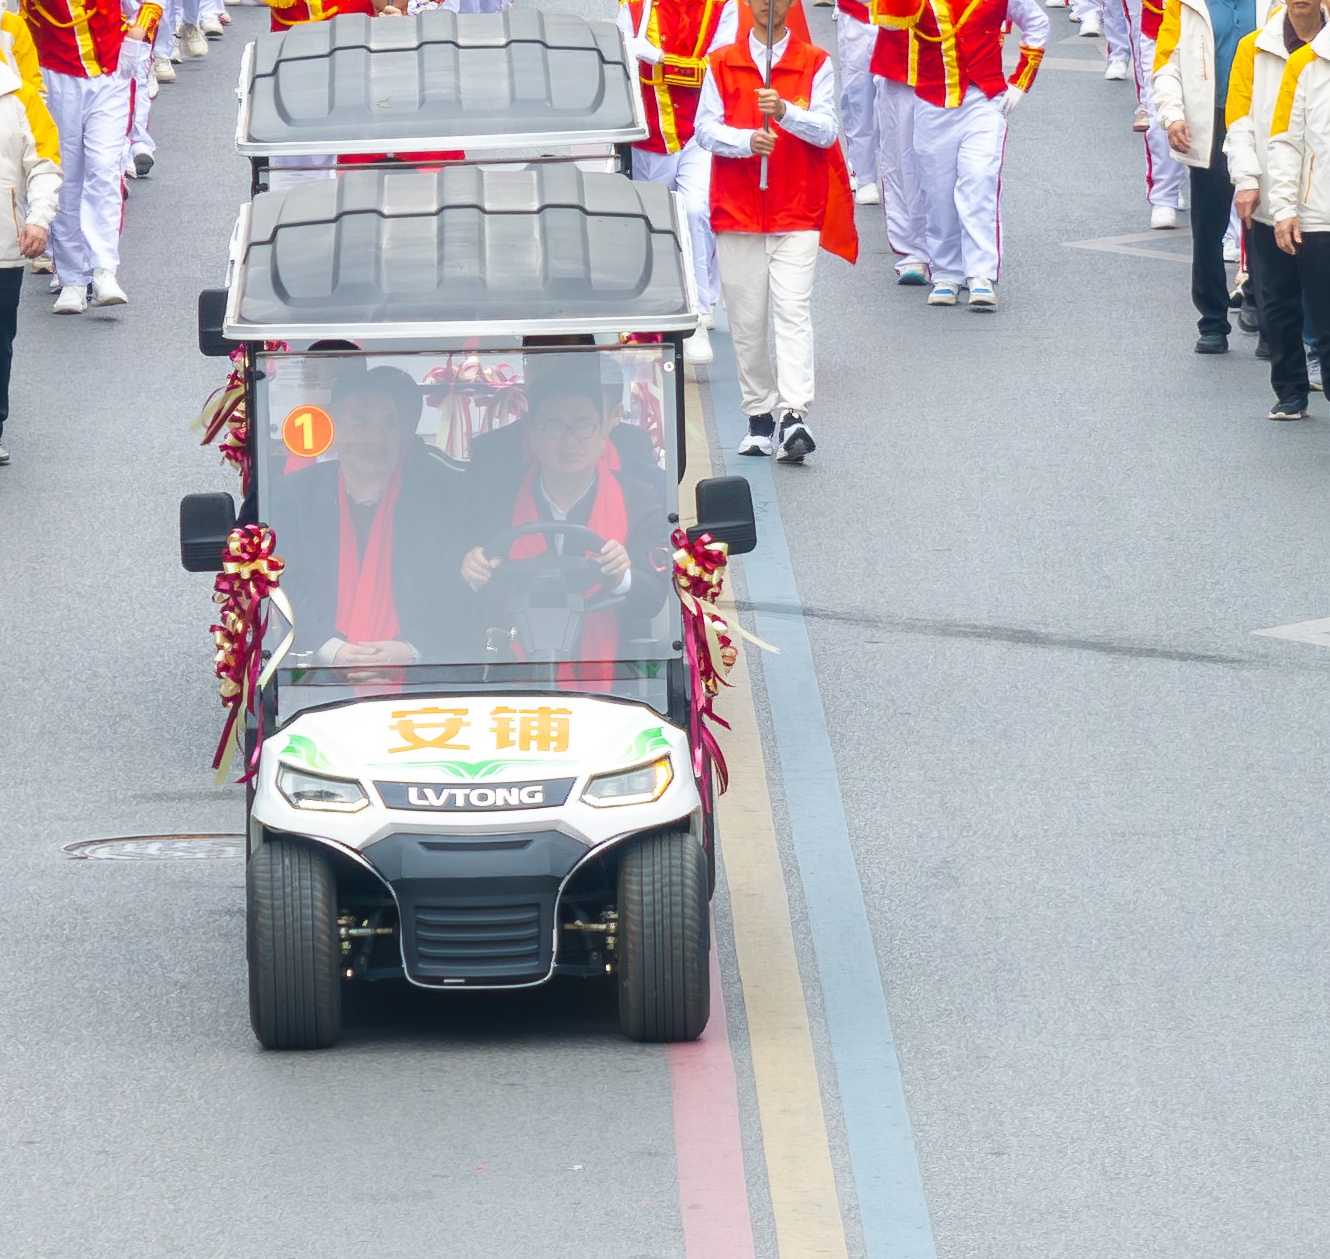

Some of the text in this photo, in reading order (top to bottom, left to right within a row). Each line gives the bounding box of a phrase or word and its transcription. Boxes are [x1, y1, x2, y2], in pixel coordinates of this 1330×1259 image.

[294, 413, 314, 450] 1
[387, 705, 573, 754] 安铺
[408, 785, 544, 807] LVTONG
